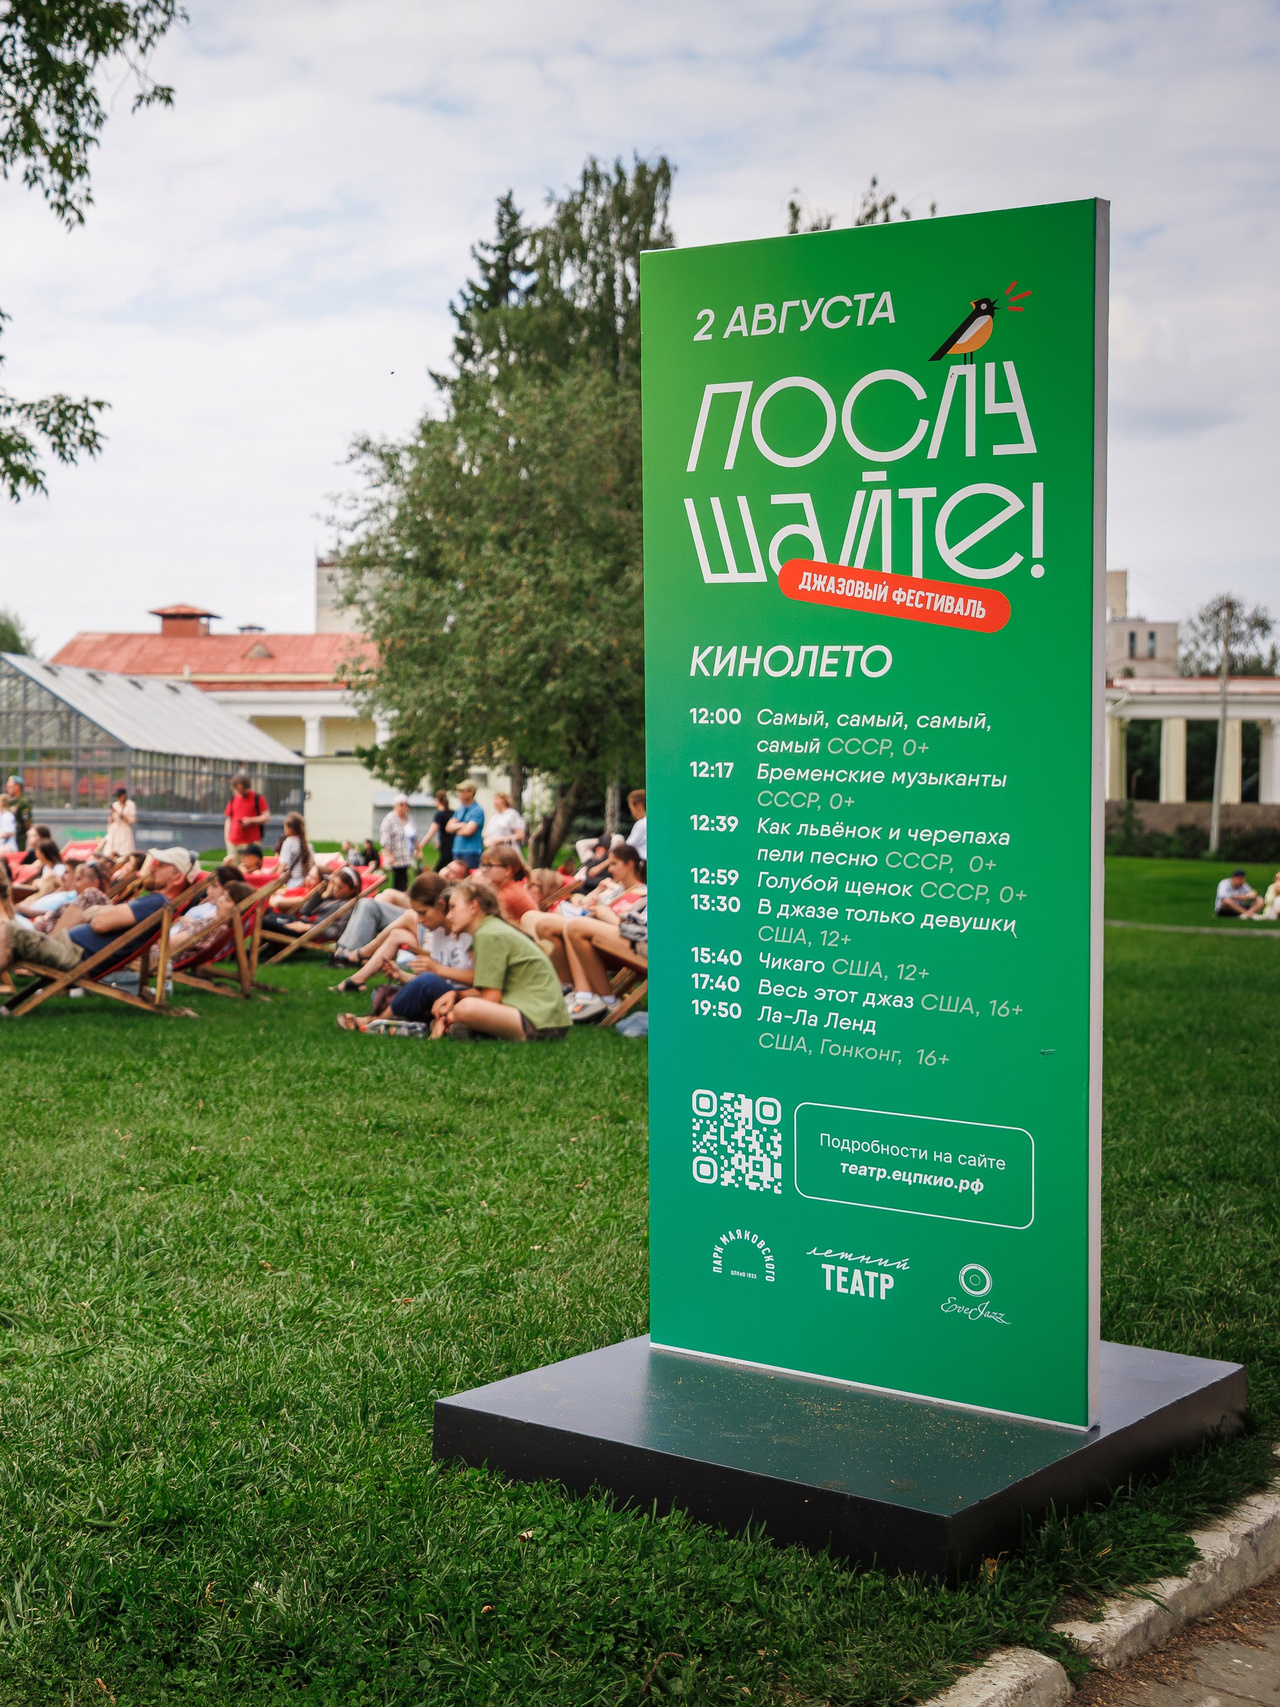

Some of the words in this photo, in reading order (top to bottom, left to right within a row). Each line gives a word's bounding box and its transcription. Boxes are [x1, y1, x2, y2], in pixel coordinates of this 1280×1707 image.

[693, 308, 716, 341] 2
[723, 291, 896, 338] АВГУСТА
[798, 571, 889, 602] ДЖАЗОВЫЙ
[892, 587, 987, 619] ФЕСТИВАЛЬ
[689, 644, 894, 678] КИНОЛЕТО
[690, 707, 742, 725] 12:00
[756, 708, 829, 729] Самый,
[837, 712, 908, 730] самый,
[916, 712, 991, 732] самый,
[756, 737, 821, 754] самый
[827, 737, 895, 758] СССР,
[903, 739, 930, 756] 0+
[690, 761, 734, 779] 12:17
[756, 763, 885, 784] Бременские
[891, 770, 1007, 789] музыканты
[757, 789, 822, 811] СССР,
[829, 793, 856, 810] 0+
[690, 814, 740, 832] 12:39
[756, 816, 791, 836] Как
[796, 819, 883, 840] львёнок
[887, 827, 902, 841] и
[907, 828, 1011, 846] черепаха
[756, 847, 805, 863] пели
[810, 850, 879, 868] песню
[885, 850, 955, 873] СССР,
[968, 856, 997, 874] 0+
[690, 867, 740, 886] 12:59
[757, 870, 840, 893] Голубой
[845, 880, 915, 898] щенок
[920, 880, 991, 904] СССР,
[999, 885, 1027, 904] 0+
[690, 894, 742, 913] 13:30
[757, 898, 773, 915] В
[776, 902, 840, 921] джазе
[845, 907, 916, 926] только
[920, 913, 1017, 934] девушки
[757, 925, 813, 947] США,
[819, 929, 852, 948] 12+
[691, 947, 743, 966] 15:40
[758, 951, 826, 974] Чикаго
[831, 957, 889, 981] США,
[897, 963, 930, 982] 12+
[691, 973, 740, 993] 17:40
[757, 978, 809, 999] Весь
[813, 987, 859, 1005] этот
[862, 992, 915, 1011] джаз
[920, 993, 981, 1019] США,
[989, 998, 1024, 1019] 16+
[691, 999, 743, 1020] 19:50
[757, 1005, 819, 1029] Ла-Ла
[823, 1011, 877, 1036] Ленд
[758, 1032, 813, 1056] США,
[819, 1038, 903, 1065] Гонконг,
[916, 1048, 950, 1067] 16+
[819, 1132, 929, 1161] Подробности
[933, 1150, 953, 1164] на
[958, 1153, 1007, 1171] сайте
[839, 1162, 985, 1195] театр.ецпкио.рф
[712, 1244, 724, 1274] ПАРК
[720, 1228, 776, 1283] МАЯКОВСКОГО
[806, 1246, 911, 1270] летний
[821, 1263, 895, 1301] ТЕАТР
